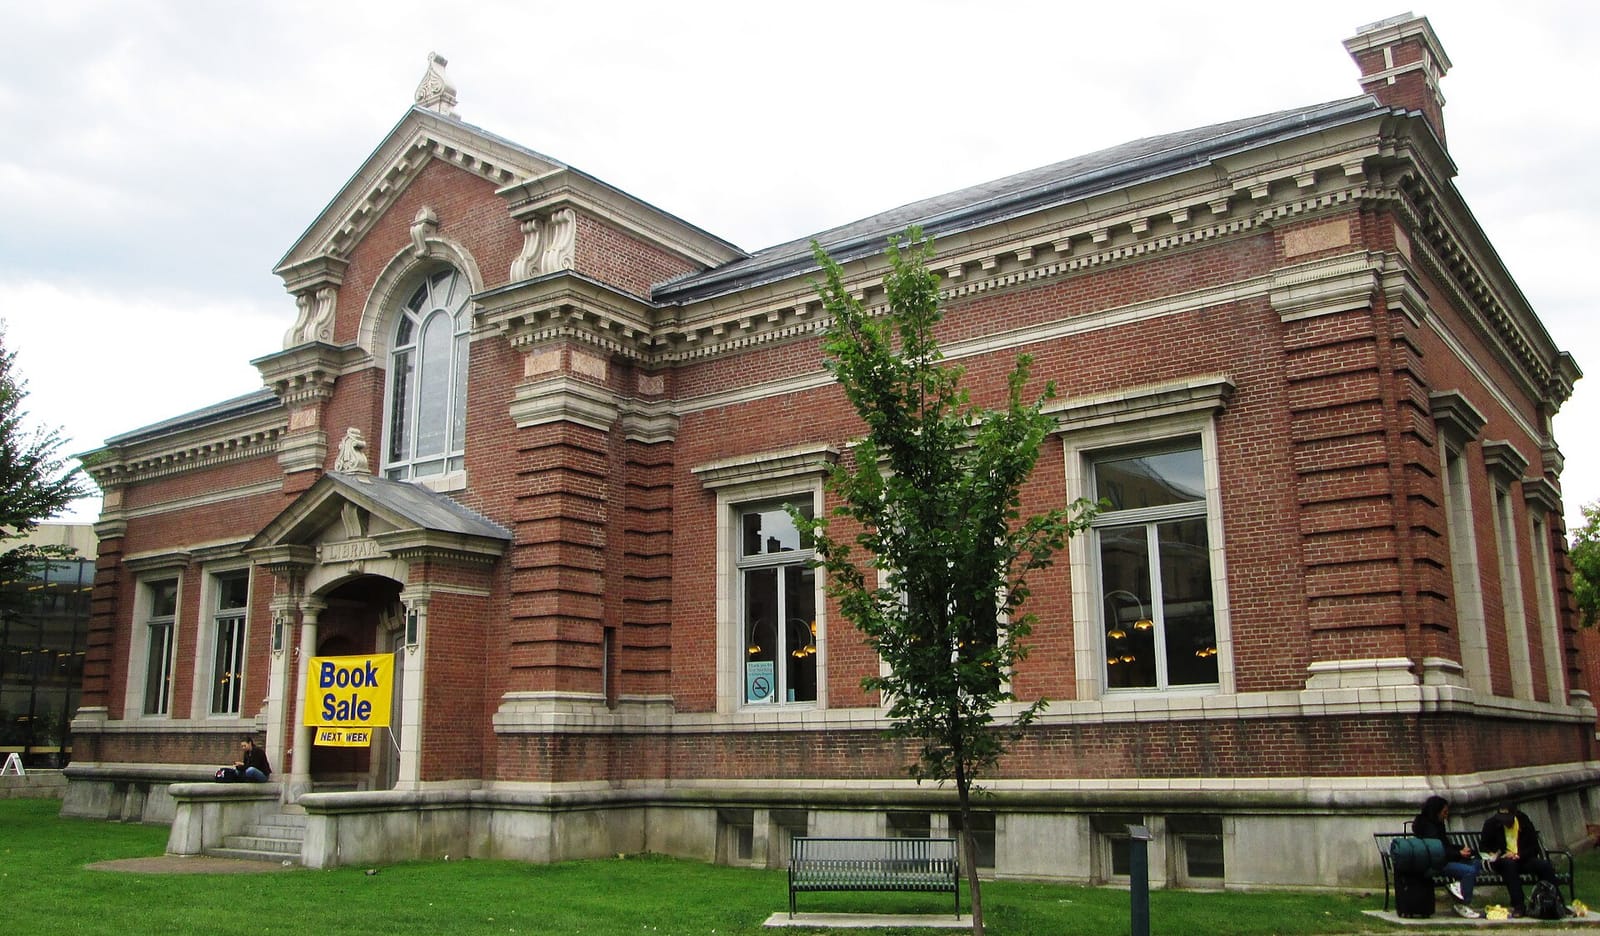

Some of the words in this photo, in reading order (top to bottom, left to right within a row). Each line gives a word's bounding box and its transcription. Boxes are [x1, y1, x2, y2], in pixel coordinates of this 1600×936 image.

[329, 542, 378, 560] LIBRAR
[320, 661, 379, 688] Book
[322, 693, 372, 721] Sale
[320, 732, 342, 742] NEXT
[346, 733, 368, 742] WEEK
